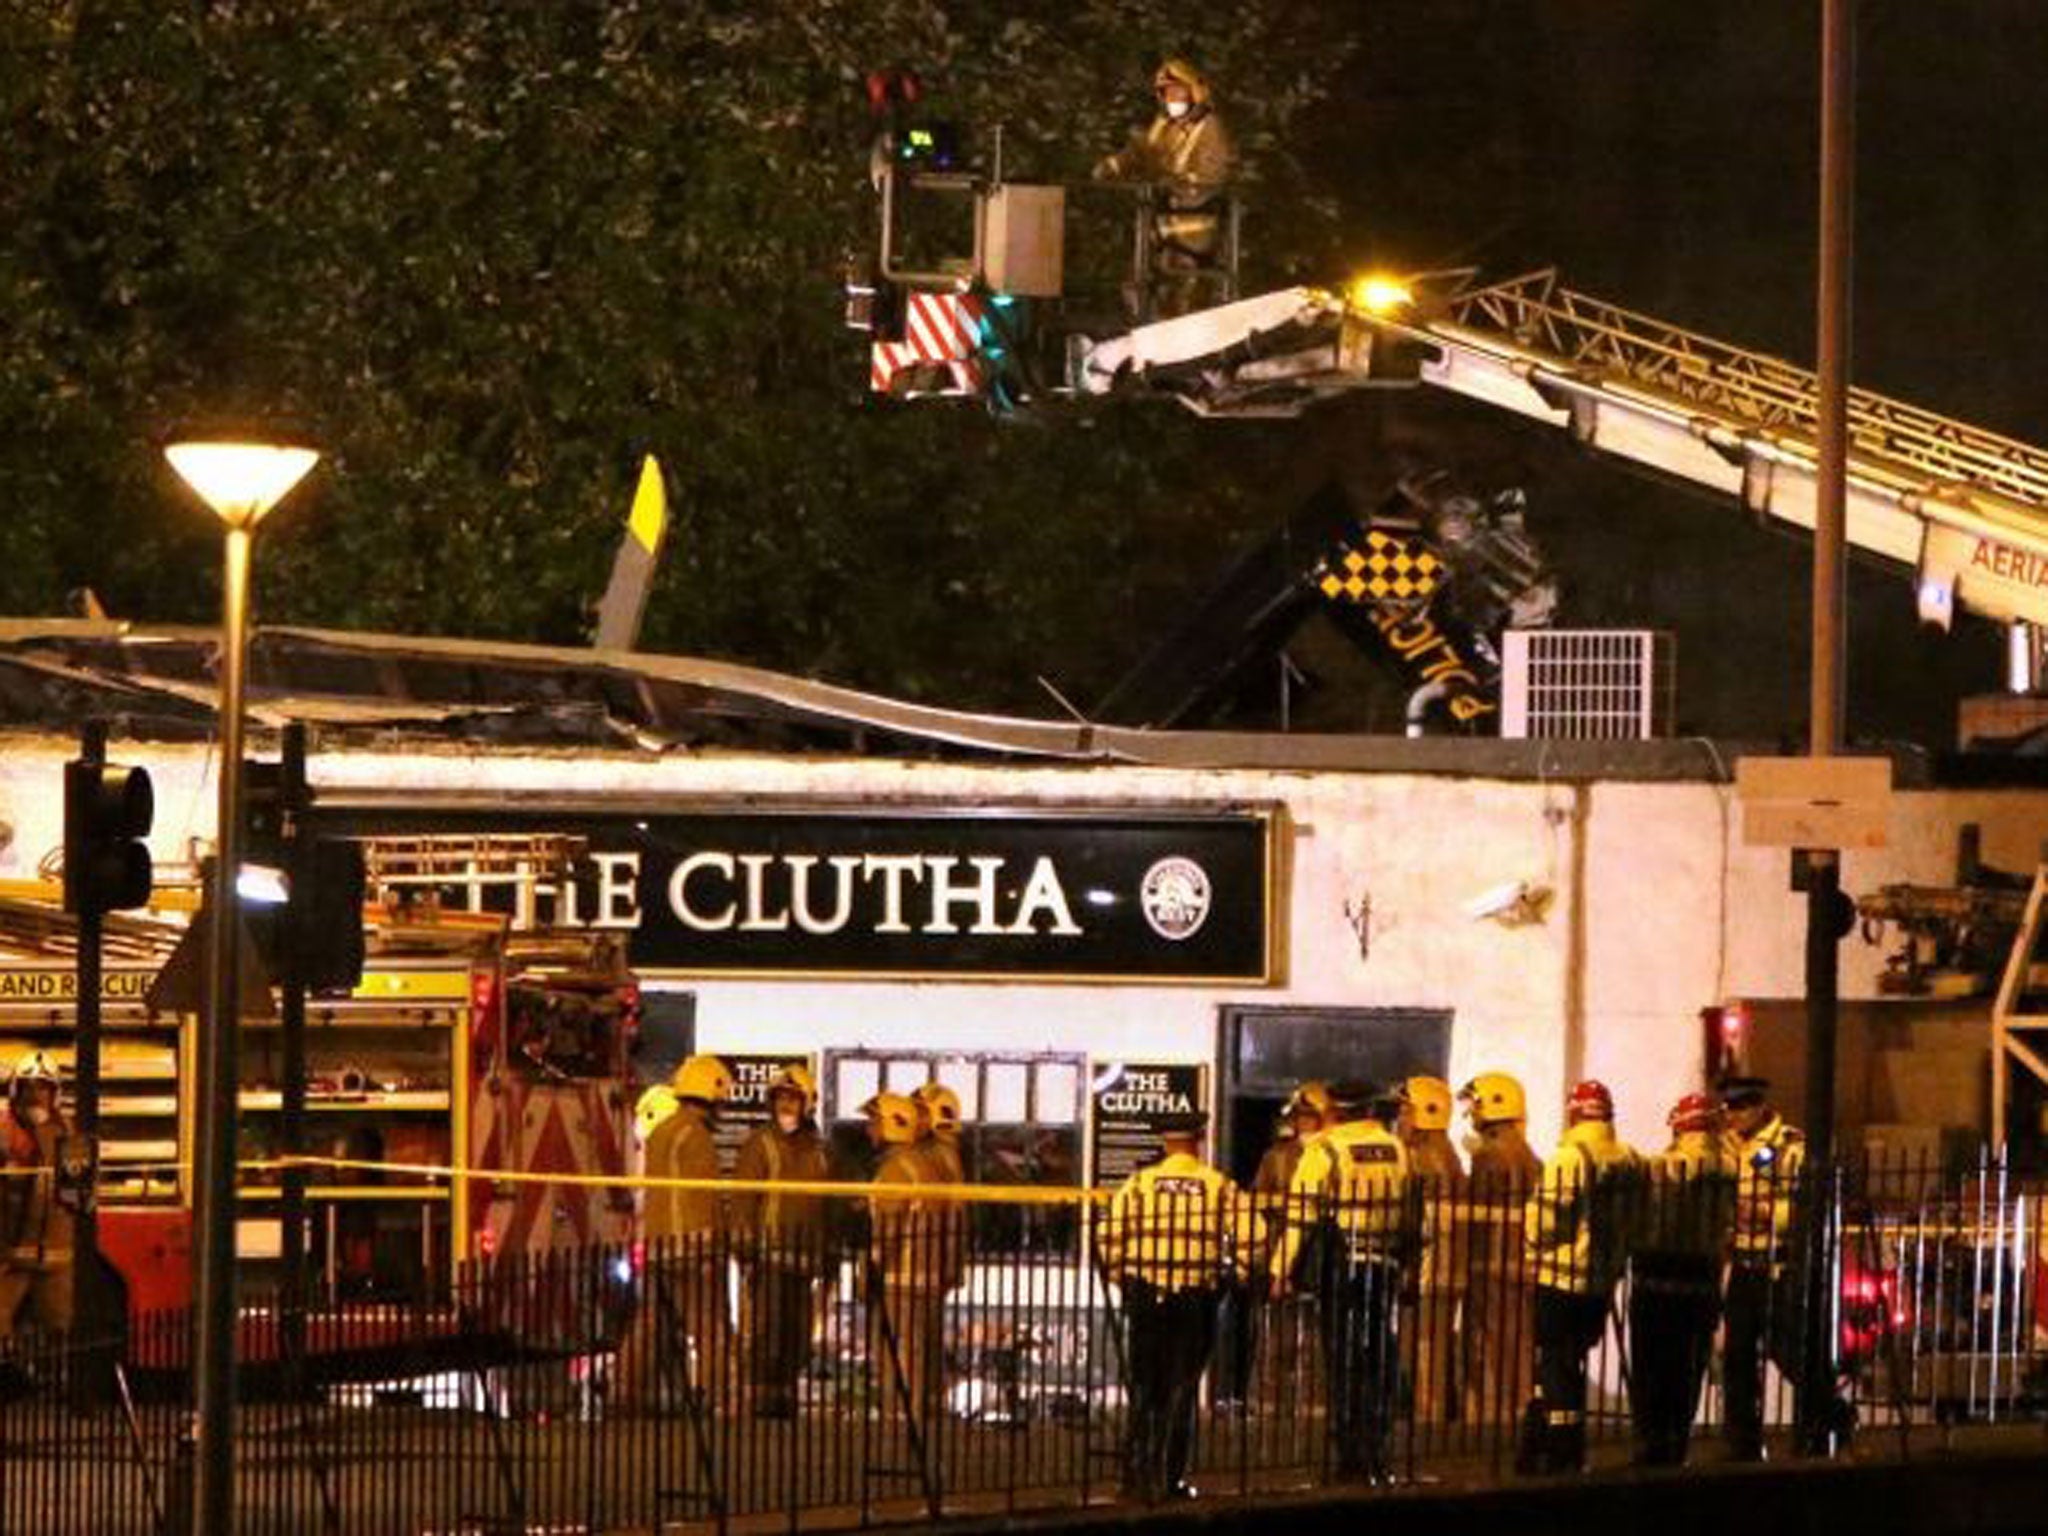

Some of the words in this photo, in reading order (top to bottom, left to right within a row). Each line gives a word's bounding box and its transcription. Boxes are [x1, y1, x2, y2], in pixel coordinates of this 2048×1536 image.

[668, 851, 1083, 935] CLUTHA
[1, 973, 55, 996] AND
[1124, 1072, 1169, 1092] THE
[1101, 1092, 1191, 1114] CLUTHA
